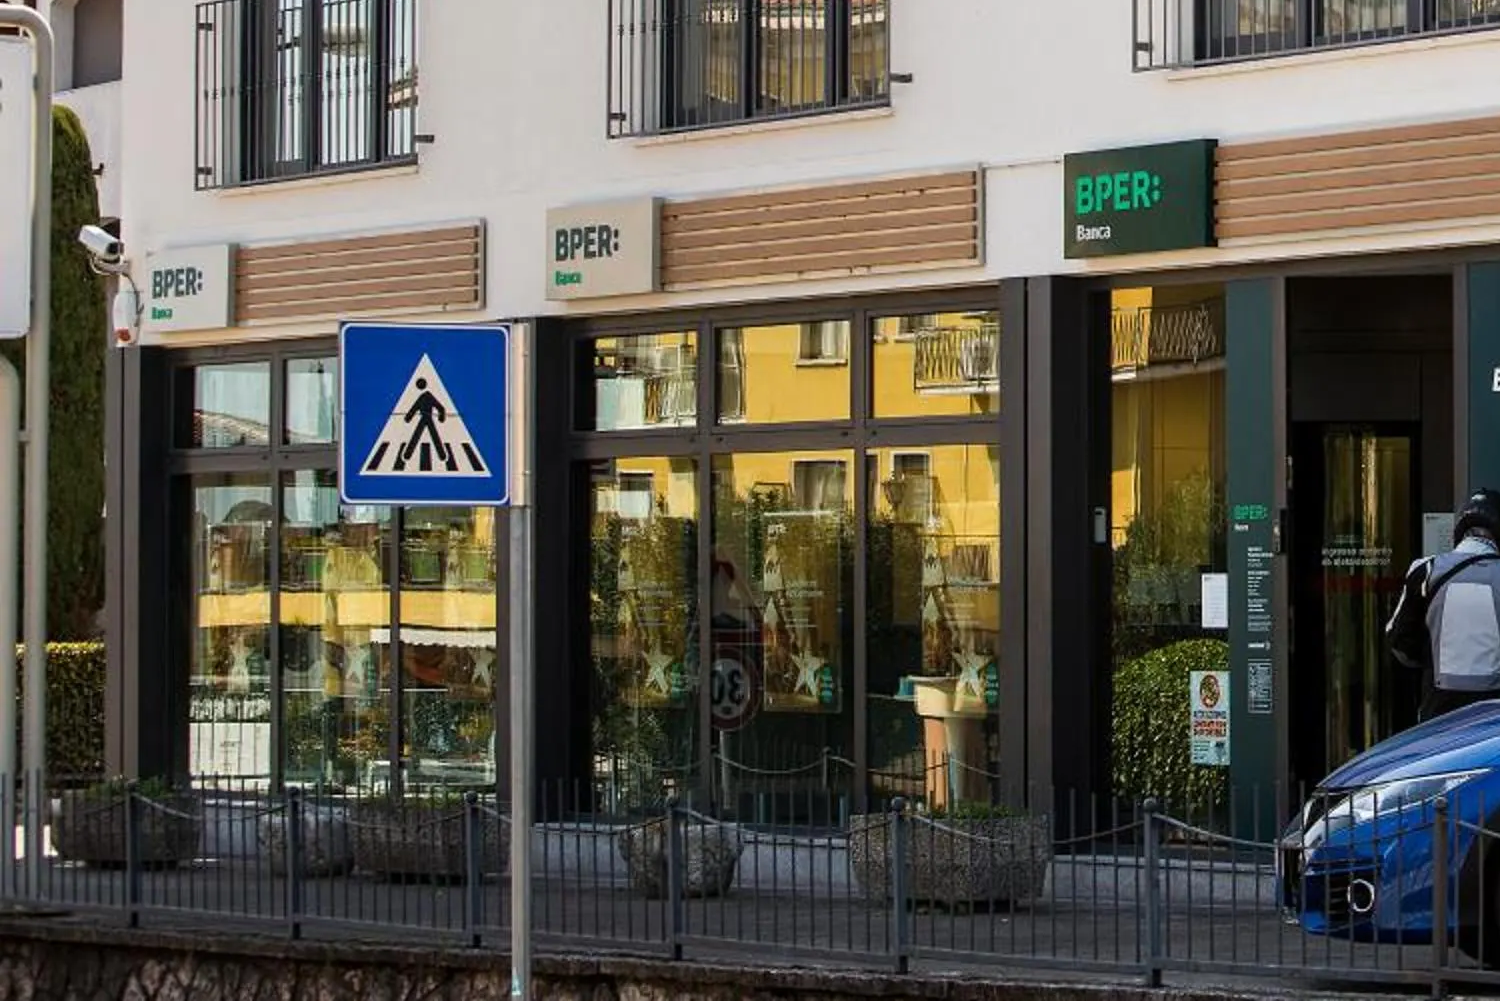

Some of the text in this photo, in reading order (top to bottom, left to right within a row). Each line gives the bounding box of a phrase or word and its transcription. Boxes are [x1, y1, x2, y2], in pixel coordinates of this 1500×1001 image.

[1075, 170, 1161, 215] BPER:
[555, 224, 619, 261] BPER:
[1076, 224, 1112, 242] Banca
[151, 267, 203, 299] BPER:
